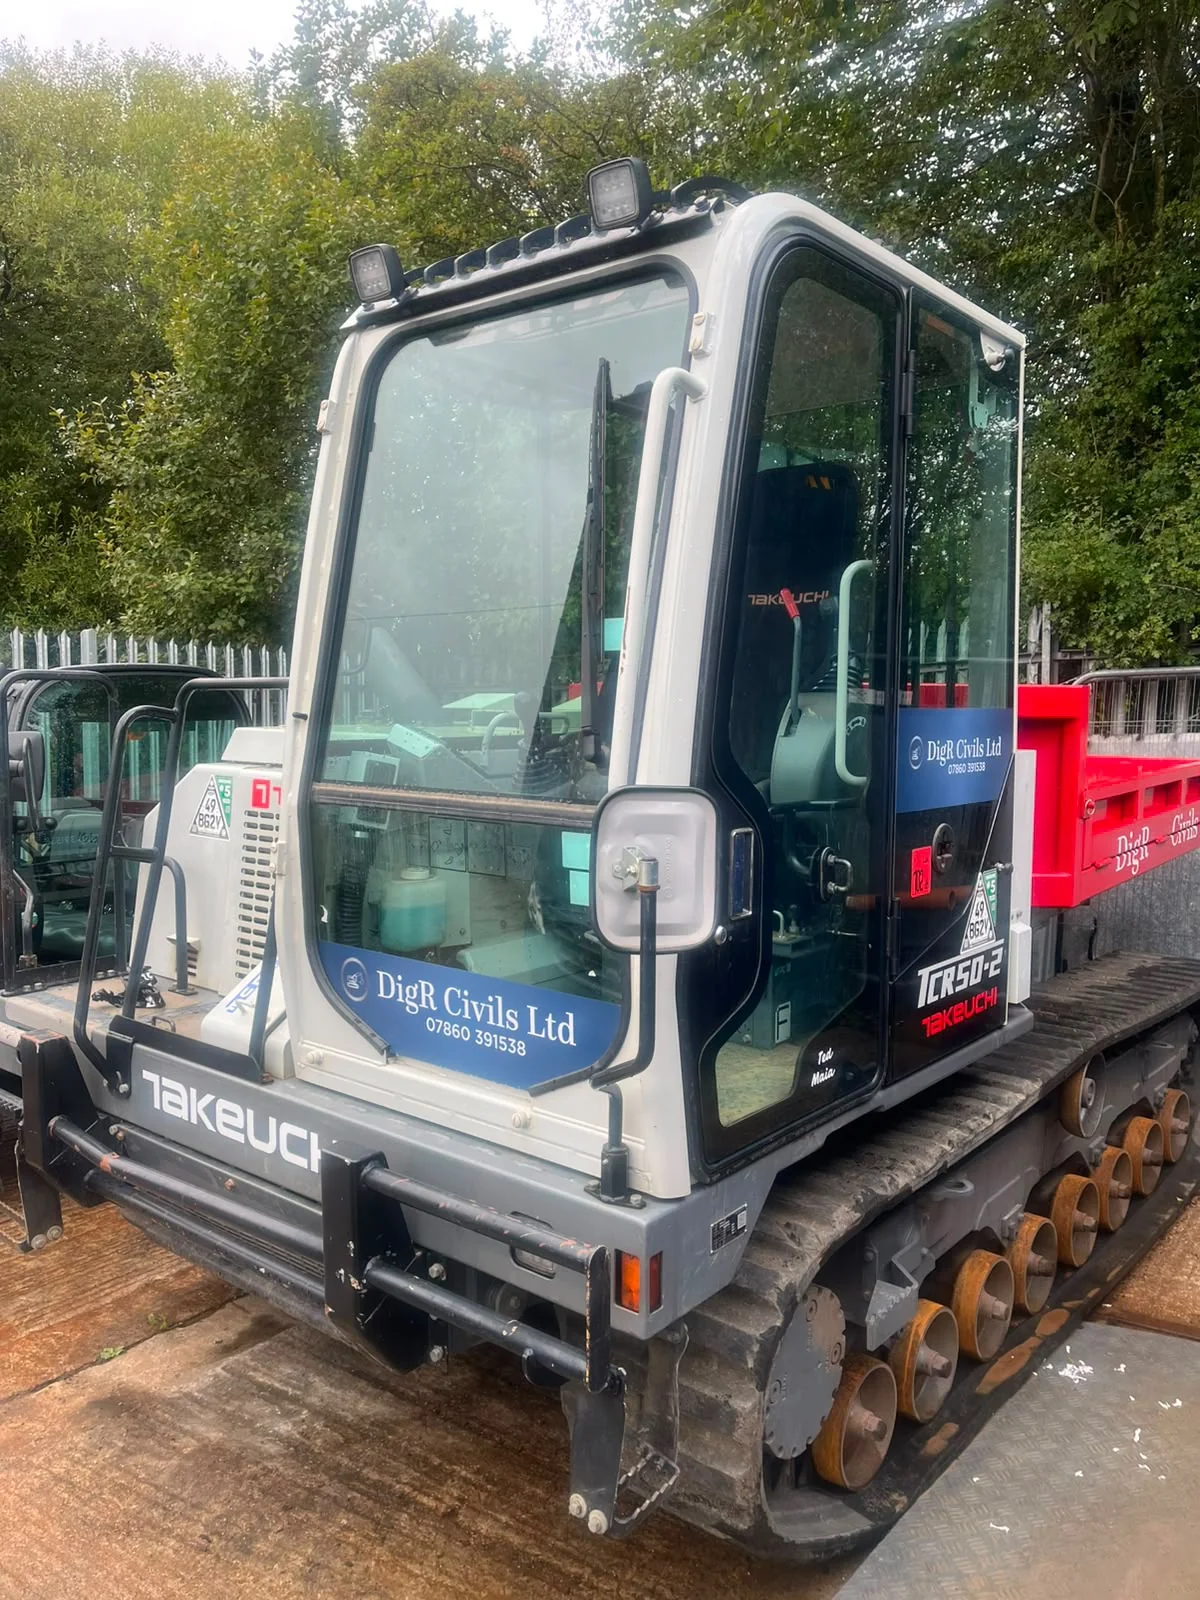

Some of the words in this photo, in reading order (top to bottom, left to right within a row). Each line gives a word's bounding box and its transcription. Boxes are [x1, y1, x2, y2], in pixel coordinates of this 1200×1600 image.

[927, 739, 954, 767] DigR
[956, 737, 984, 759] Civils
[985, 736, 1002, 757] Ltd
[947, 763, 966, 775] 07860
[967, 761, 986, 773] 391538
[205, 798, 216, 813] 49
[1115, 826, 1150, 875] DigR
[1170, 807, 1199, 847] Civils
[975, 901, 985, 918] 49
[917, 938, 1005, 1009] TCR50-2
[376, 970, 437, 1015] DigR
[443, 986, 519, 1031] Civils
[526, 1004, 577, 1047] Ltd
[921, 986, 998, 1038] TAKEUCHI
[426, 1017, 470, 1041] 07860
[475, 1029, 527, 1056] 391538
[818, 1047, 834, 1065] Ted
[810, 1067, 836, 1087] Maia
